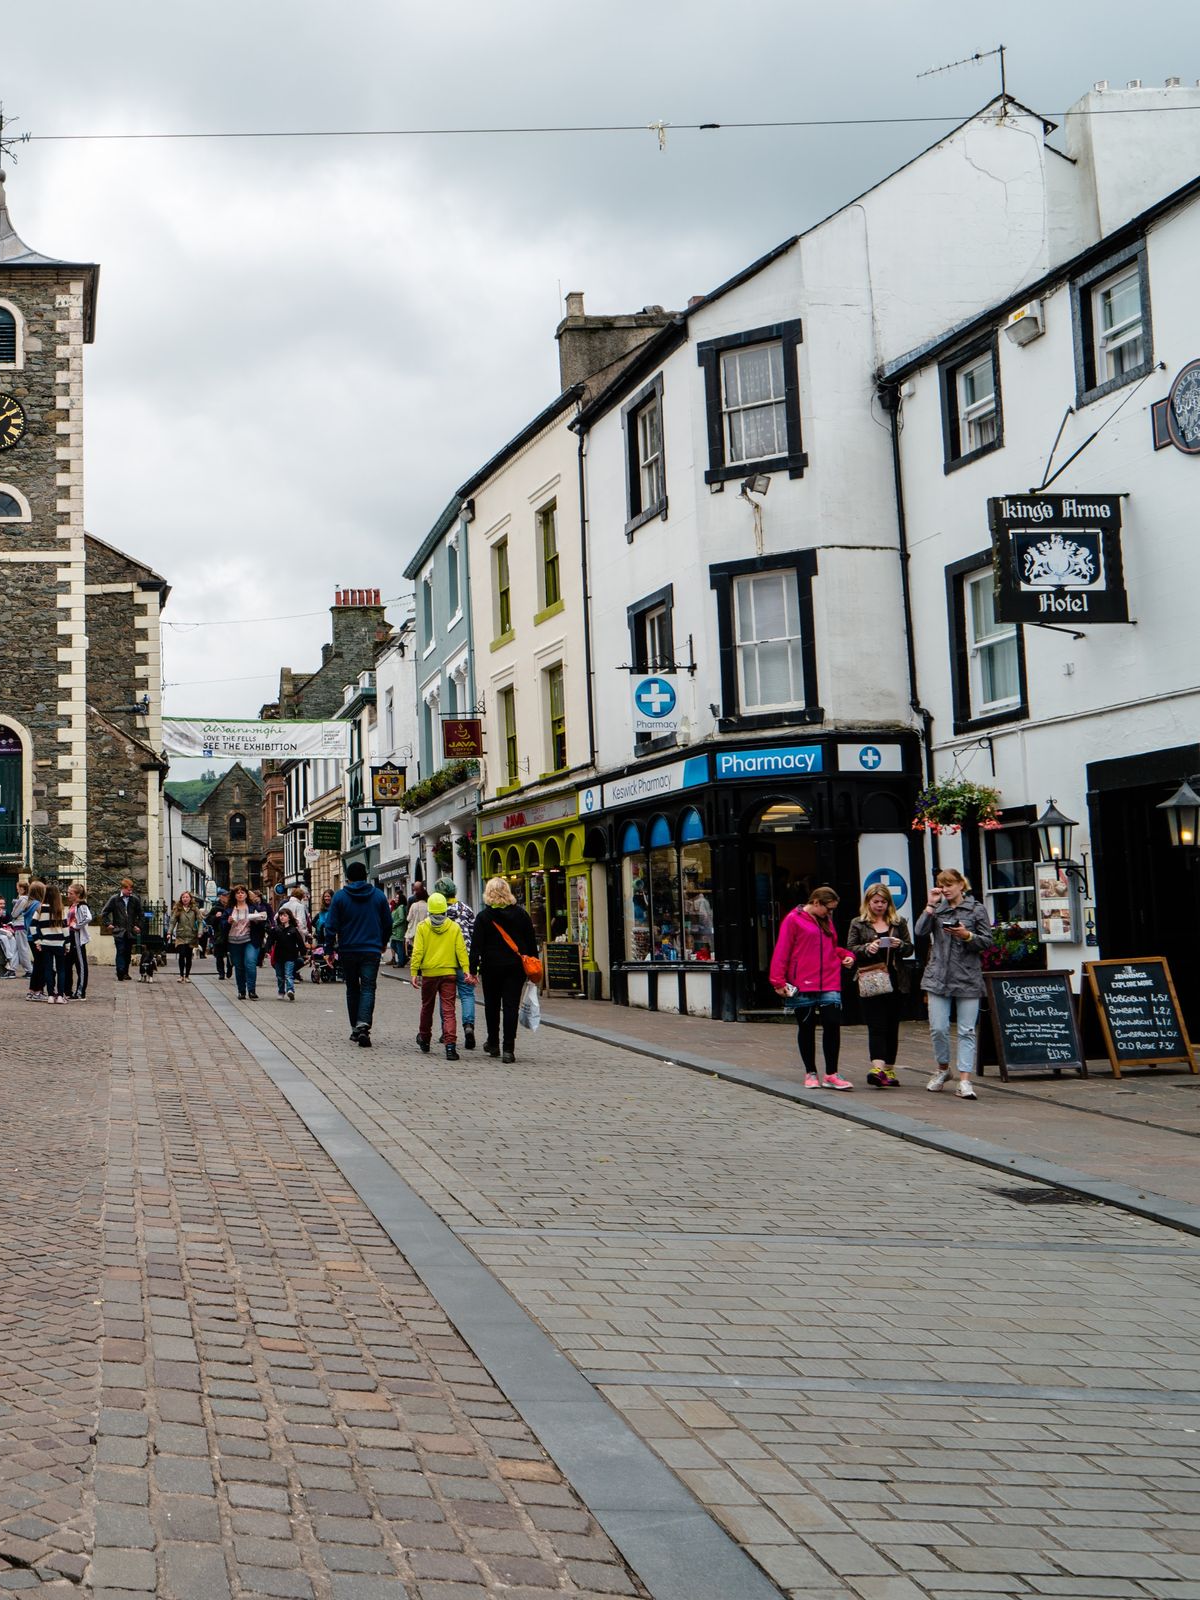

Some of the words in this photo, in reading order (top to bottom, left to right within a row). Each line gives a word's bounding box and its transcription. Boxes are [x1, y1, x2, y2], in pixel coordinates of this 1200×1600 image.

[1062, 499, 1111, 518] Arms
[1039, 594, 1088, 612] Hotel
[637, 720, 678, 729] Pharmacy
[202, 742, 220, 750] SEE
[223, 742, 241, 750] THE
[721, 753, 815, 773] Pharmacy
[612, 780, 638, 800] Keswick
[638, 774, 671, 794] Pharmacy
[504, 811, 527, 830] JAVA
[1028, 1006, 1046, 1017] Pork
[1118, 1042, 1134, 1050] OLD
